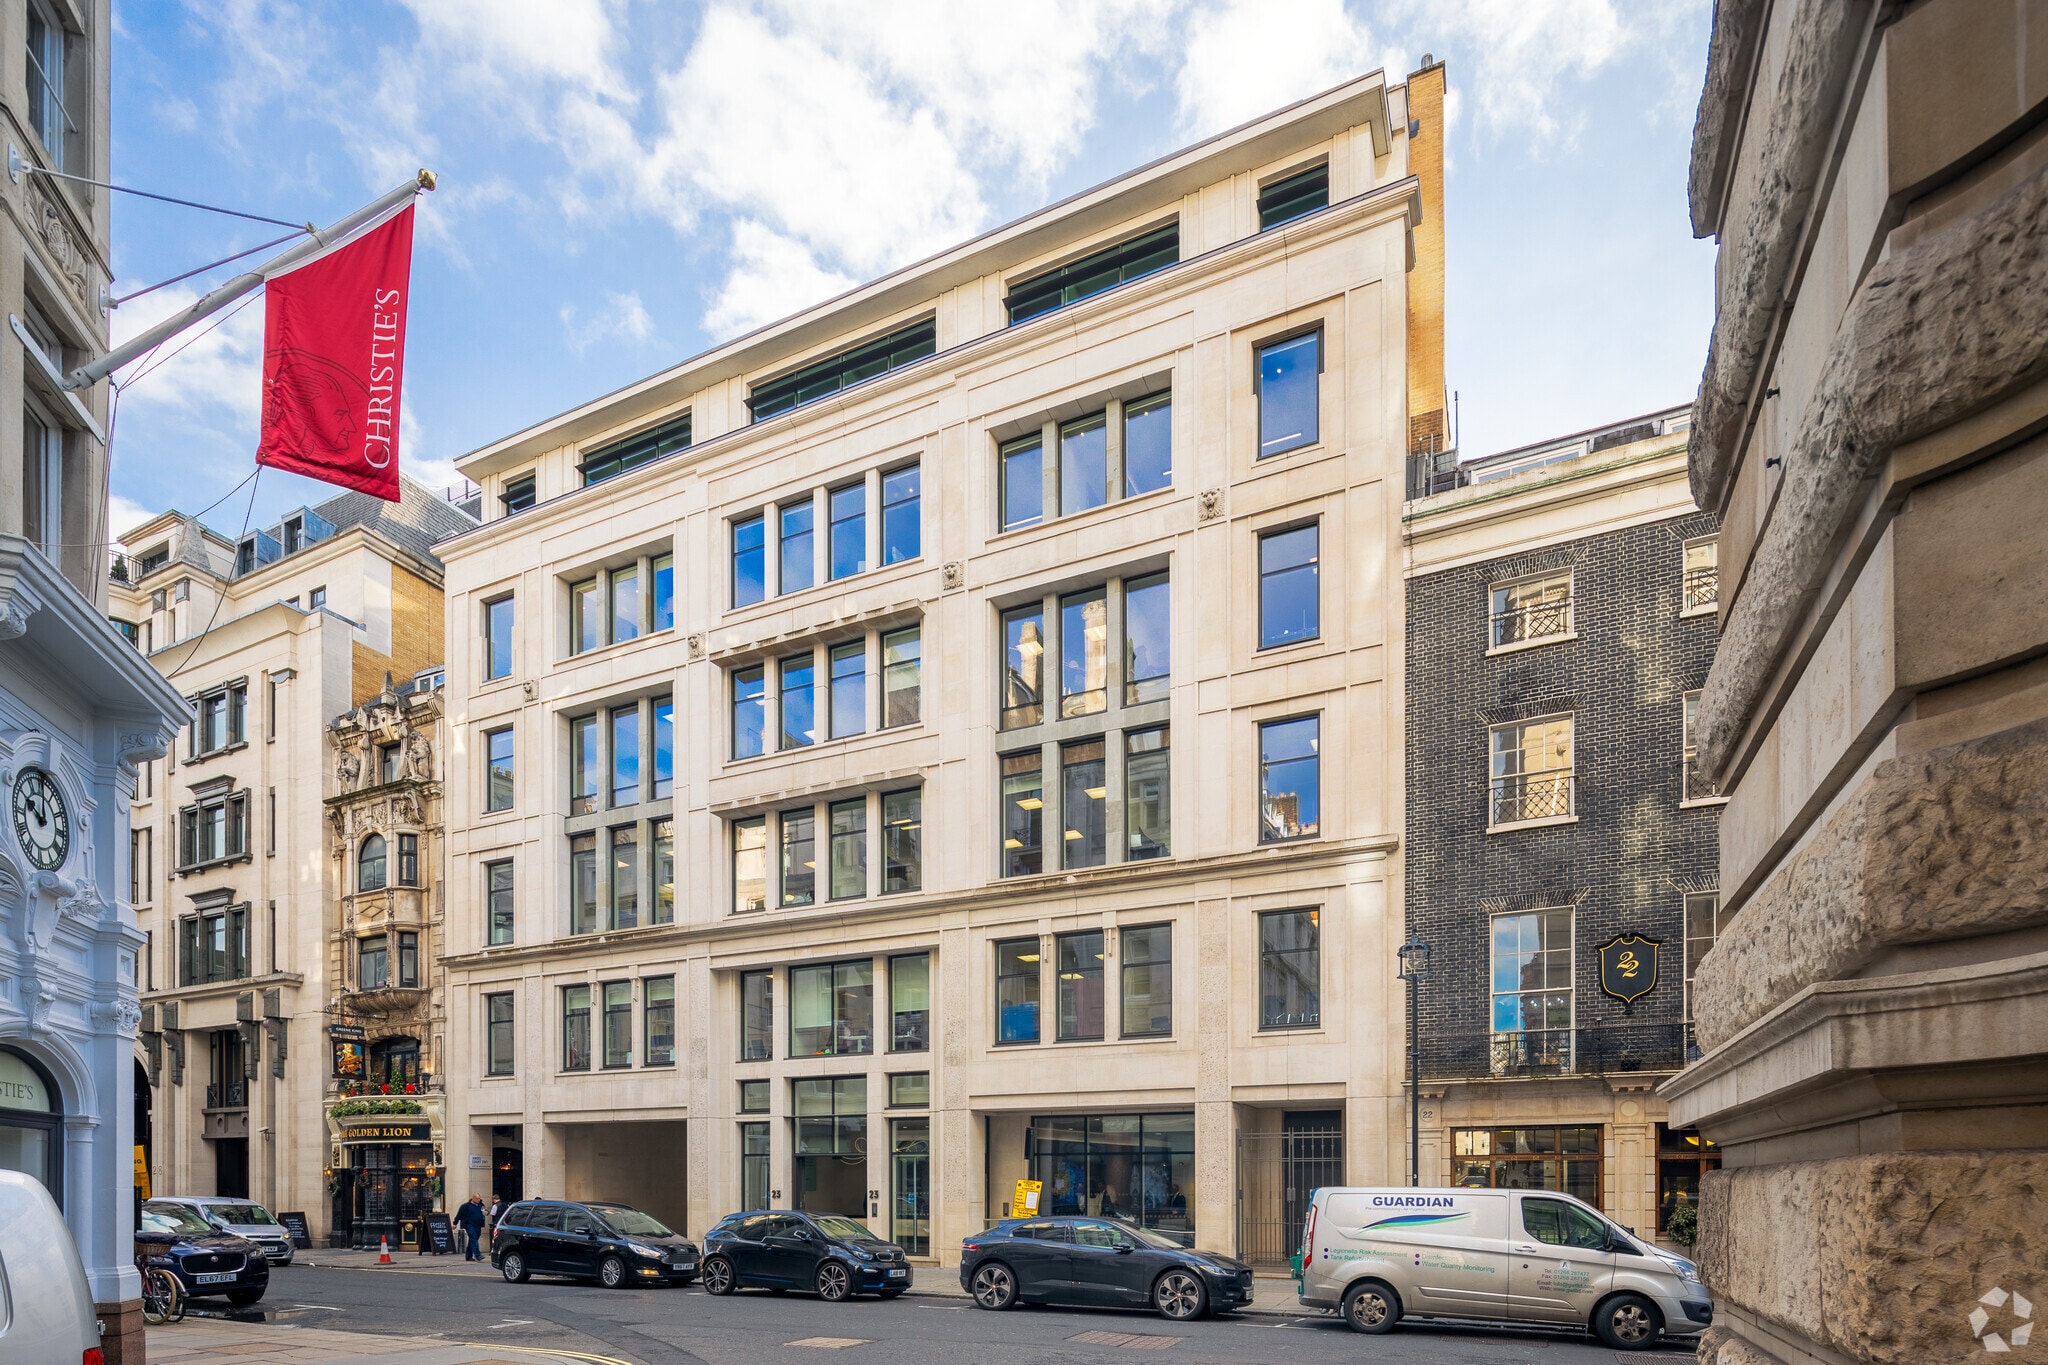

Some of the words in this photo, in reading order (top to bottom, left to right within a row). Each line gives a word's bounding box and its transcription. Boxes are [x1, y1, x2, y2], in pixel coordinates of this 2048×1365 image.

[364, 289, 400, 469] CHRISTIE'S
[1617, 951, 1639, 977] 22
[1422, 1110, 1433, 1119] 22
[348, 1128, 380, 1137] GOLDEN
[383, 1127, 412, 1137] LION
[771, 1190, 781, 1199] 23
[869, 1190, 879, 1199] 23
[1372, 1196, 1454, 1207] GUARDIAN
[1330, 1247, 1358, 1255] Legionella
[1373, 1249, 1408, 1258] Assessment
[1440, 1262, 1462, 1271] Quality
[1463, 1264, 1496, 1274] Monitoring
